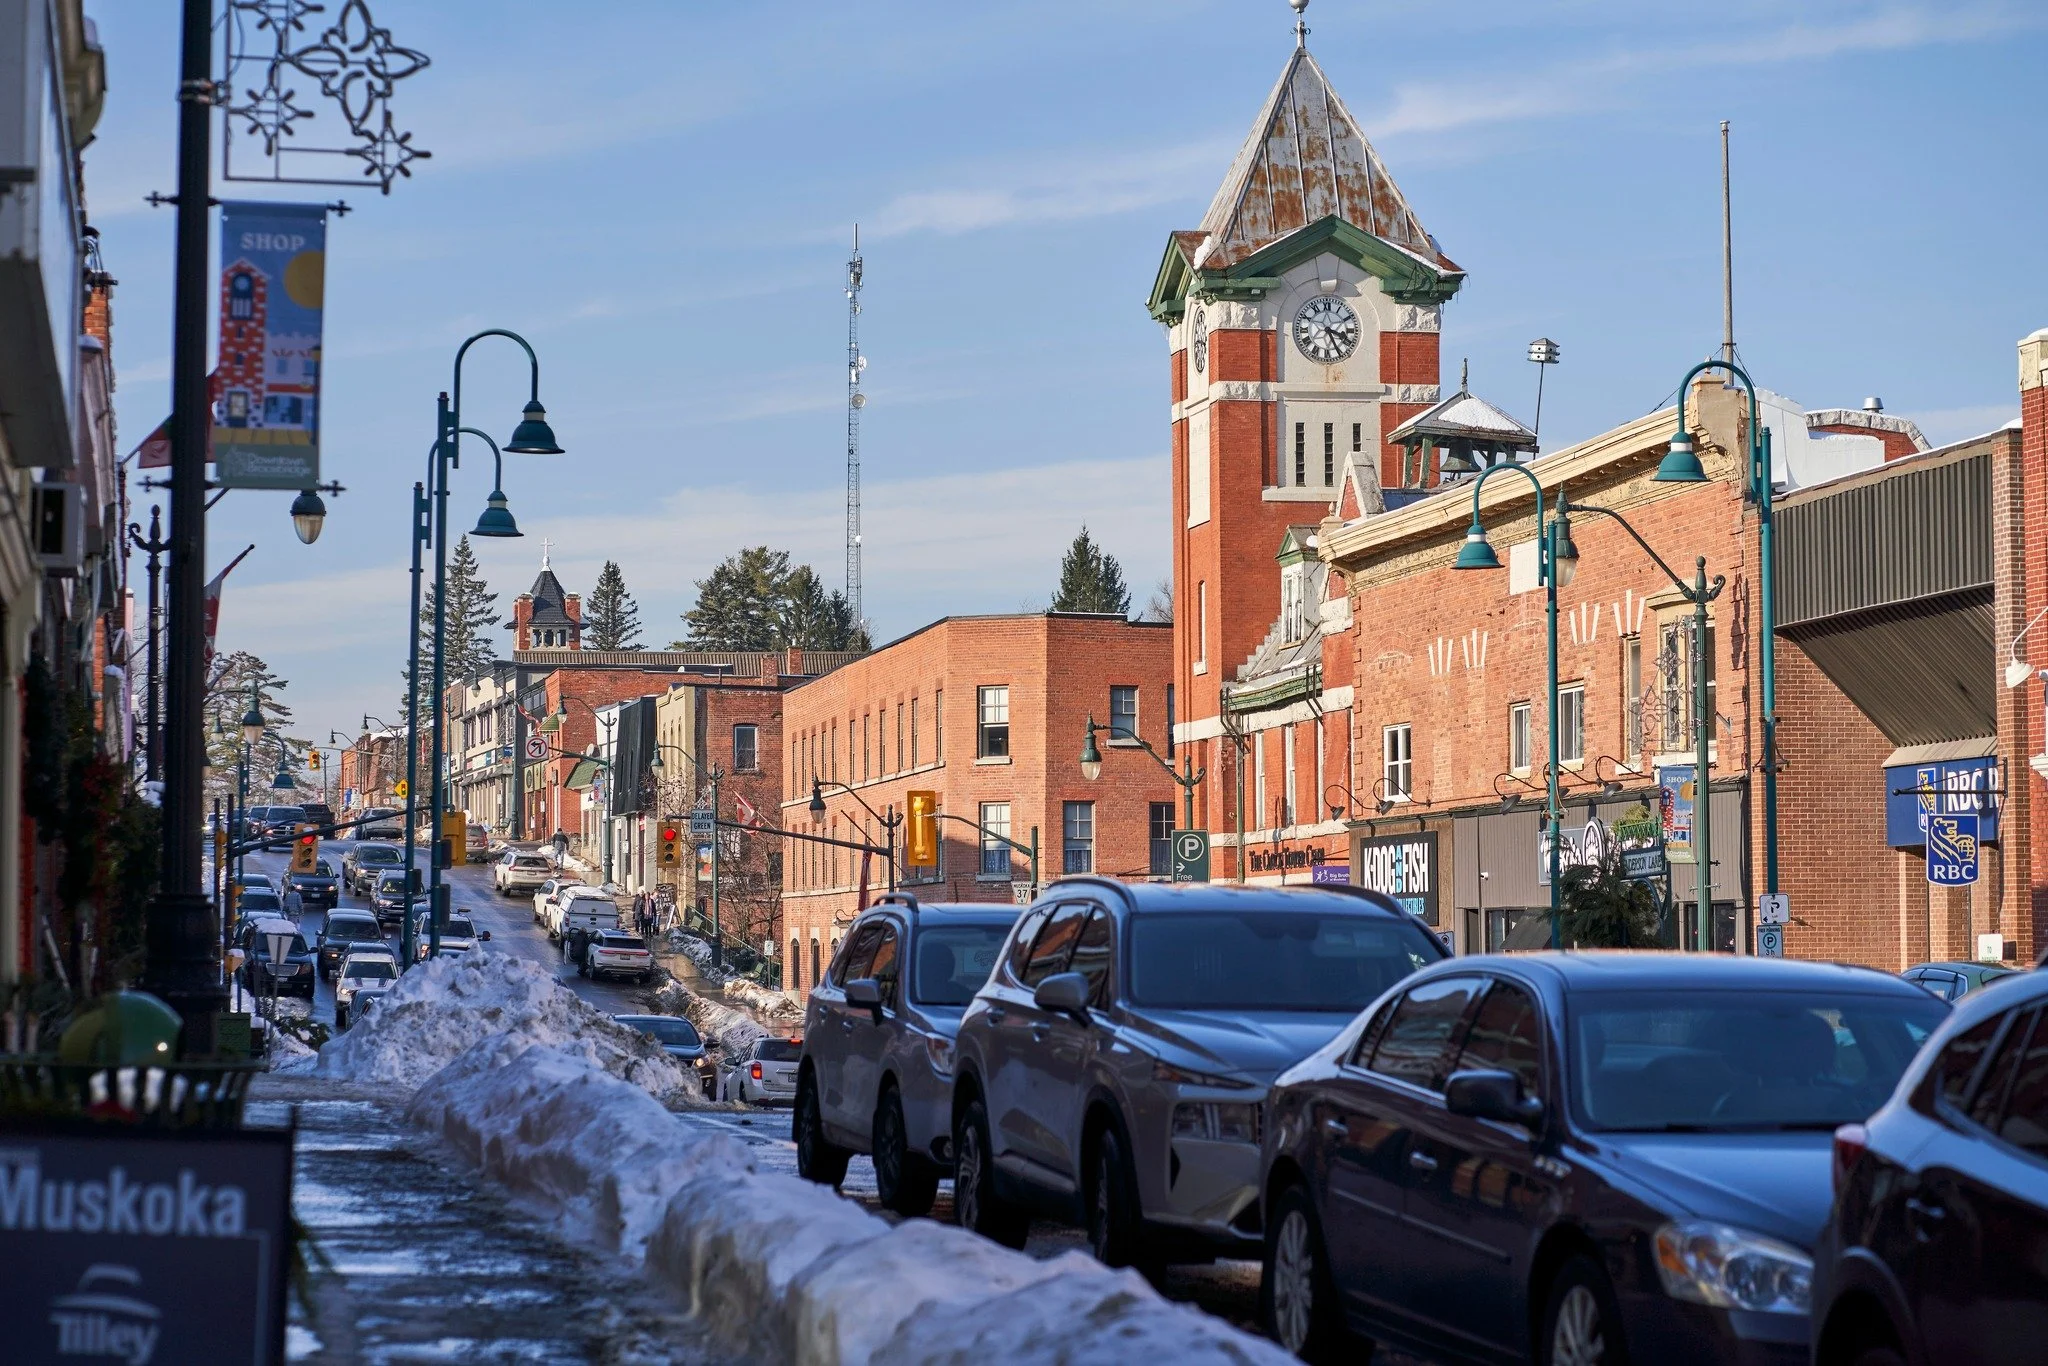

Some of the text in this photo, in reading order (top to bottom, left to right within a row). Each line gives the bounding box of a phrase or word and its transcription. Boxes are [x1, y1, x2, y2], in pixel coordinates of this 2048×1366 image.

[241, 232, 306, 251] SHOP
[1947, 768, 1984, 812] RBC
[692, 812, 713, 820] DELAYED
[694, 822, 711, 830] GREEN
[1184, 838, 1199, 857] P
[1176, 873, 1193, 881] Free
[1364, 845, 1396, 894] K-DOG
[1402, 843, 1429, 893] FISH
[1933, 865, 1974, 880] RBC
[1017, 889, 1027, 898] 37
[1767, 937, 1774, 945] P
[0, 1165, 247, 1238] Muskoka
[50, 1311, 160, 1366] Tilley
